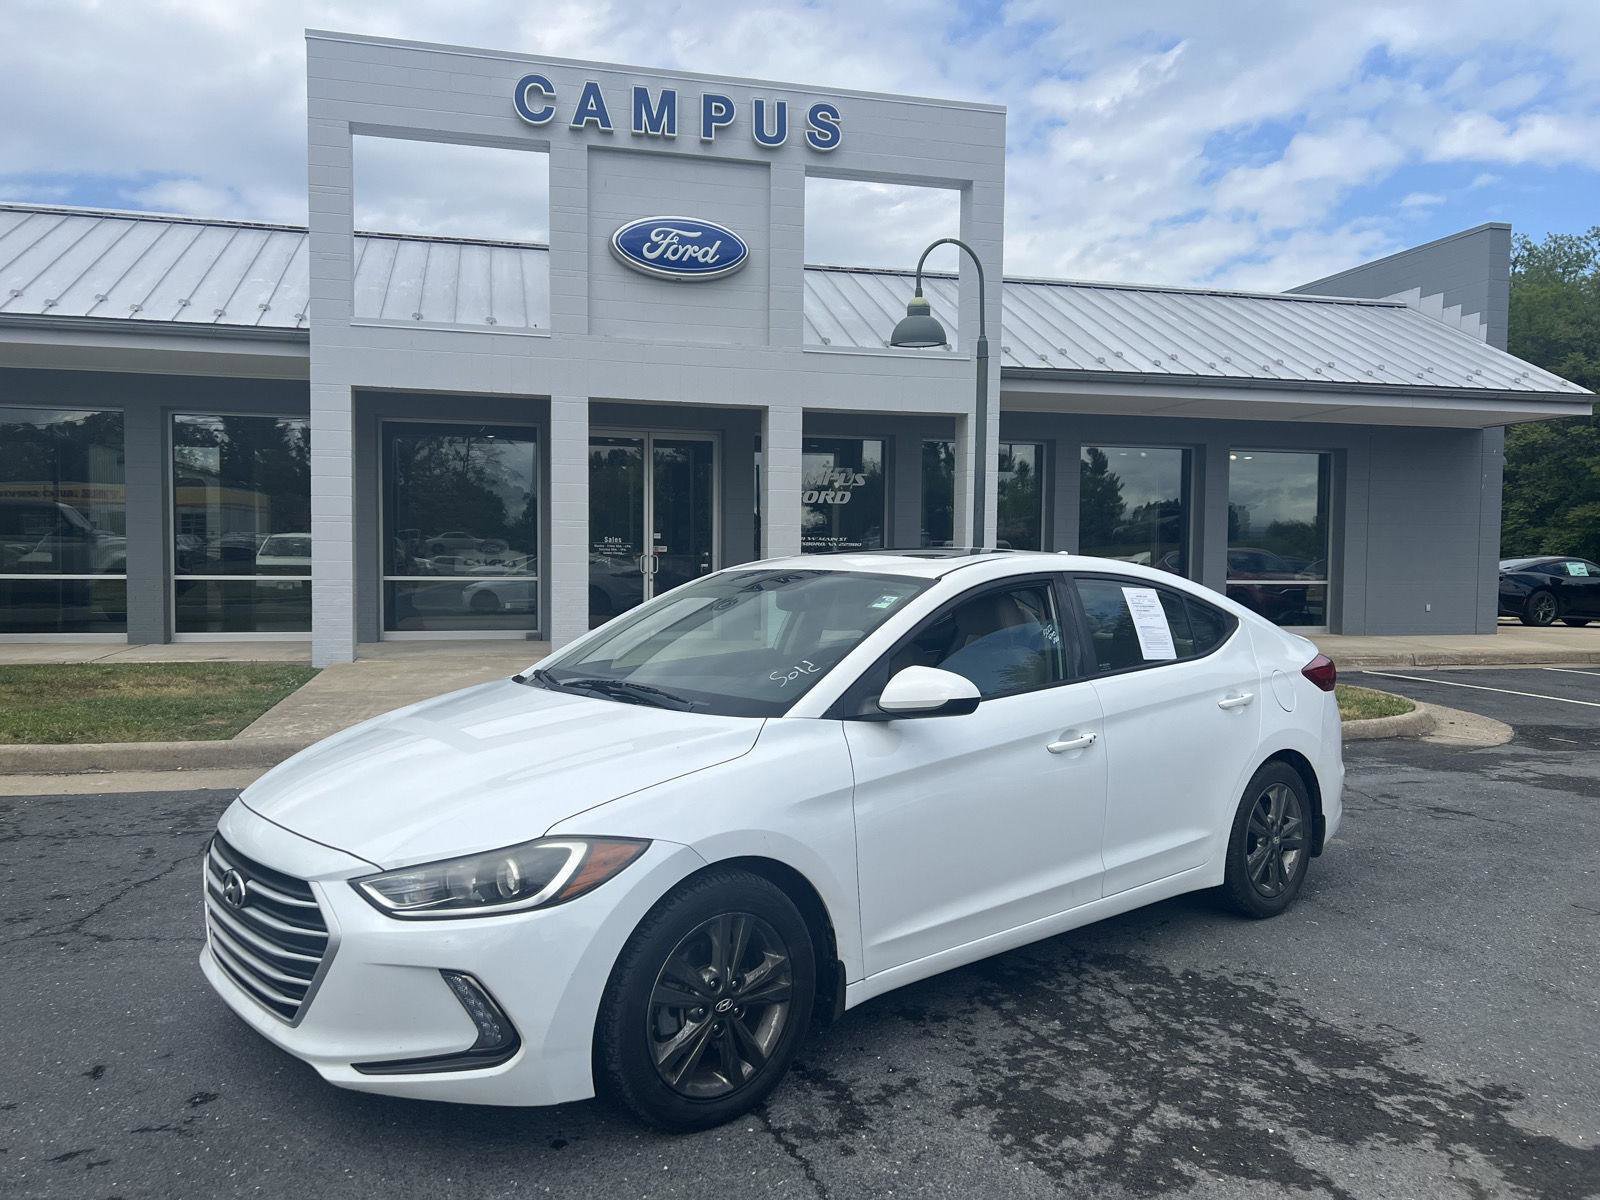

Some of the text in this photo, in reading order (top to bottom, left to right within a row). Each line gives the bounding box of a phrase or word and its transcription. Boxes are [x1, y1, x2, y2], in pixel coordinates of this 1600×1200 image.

[512, 73, 843, 152] CAMPUS
[642, 227, 724, 265] Ford
[803, 473, 868, 486] MPUS
[802, 490, 852, 504] ORD
